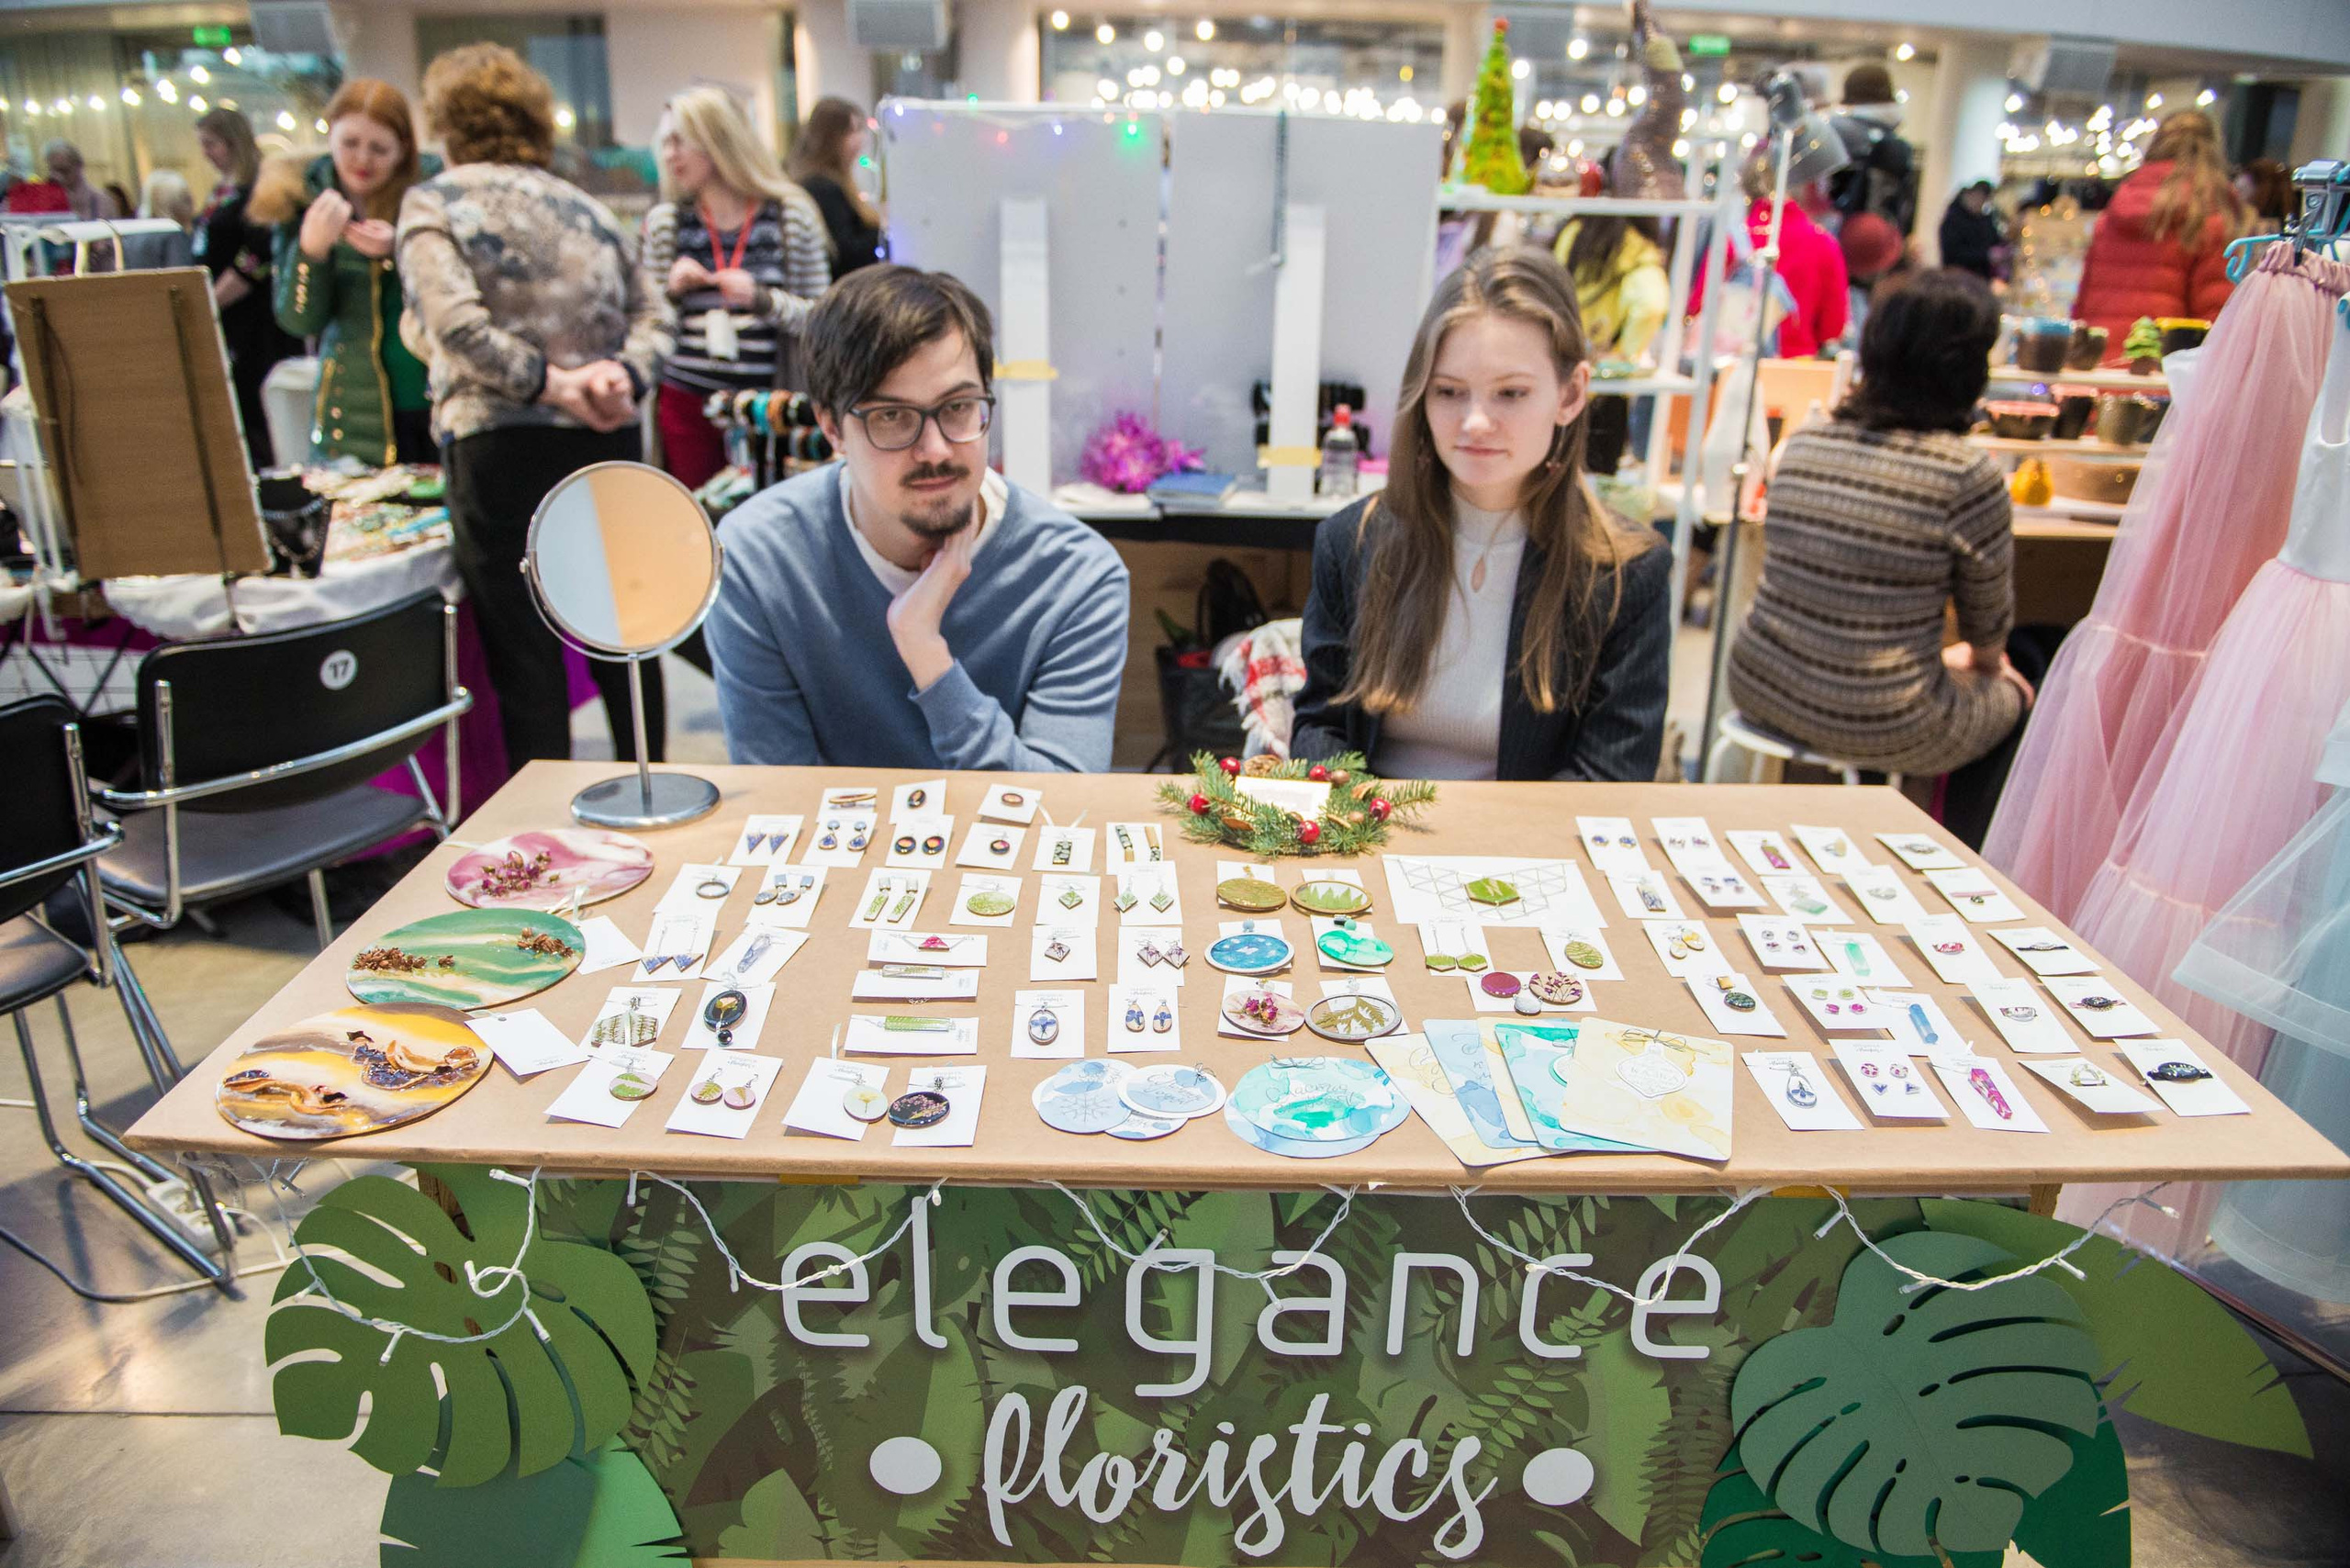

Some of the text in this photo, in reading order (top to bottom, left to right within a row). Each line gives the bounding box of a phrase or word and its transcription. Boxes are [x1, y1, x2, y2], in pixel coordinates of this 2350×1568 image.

[329, 659, 350, 678] 17
[783, 1196, 1721, 1395] elegance
[982, 1386, 1497, 1559] floristics
